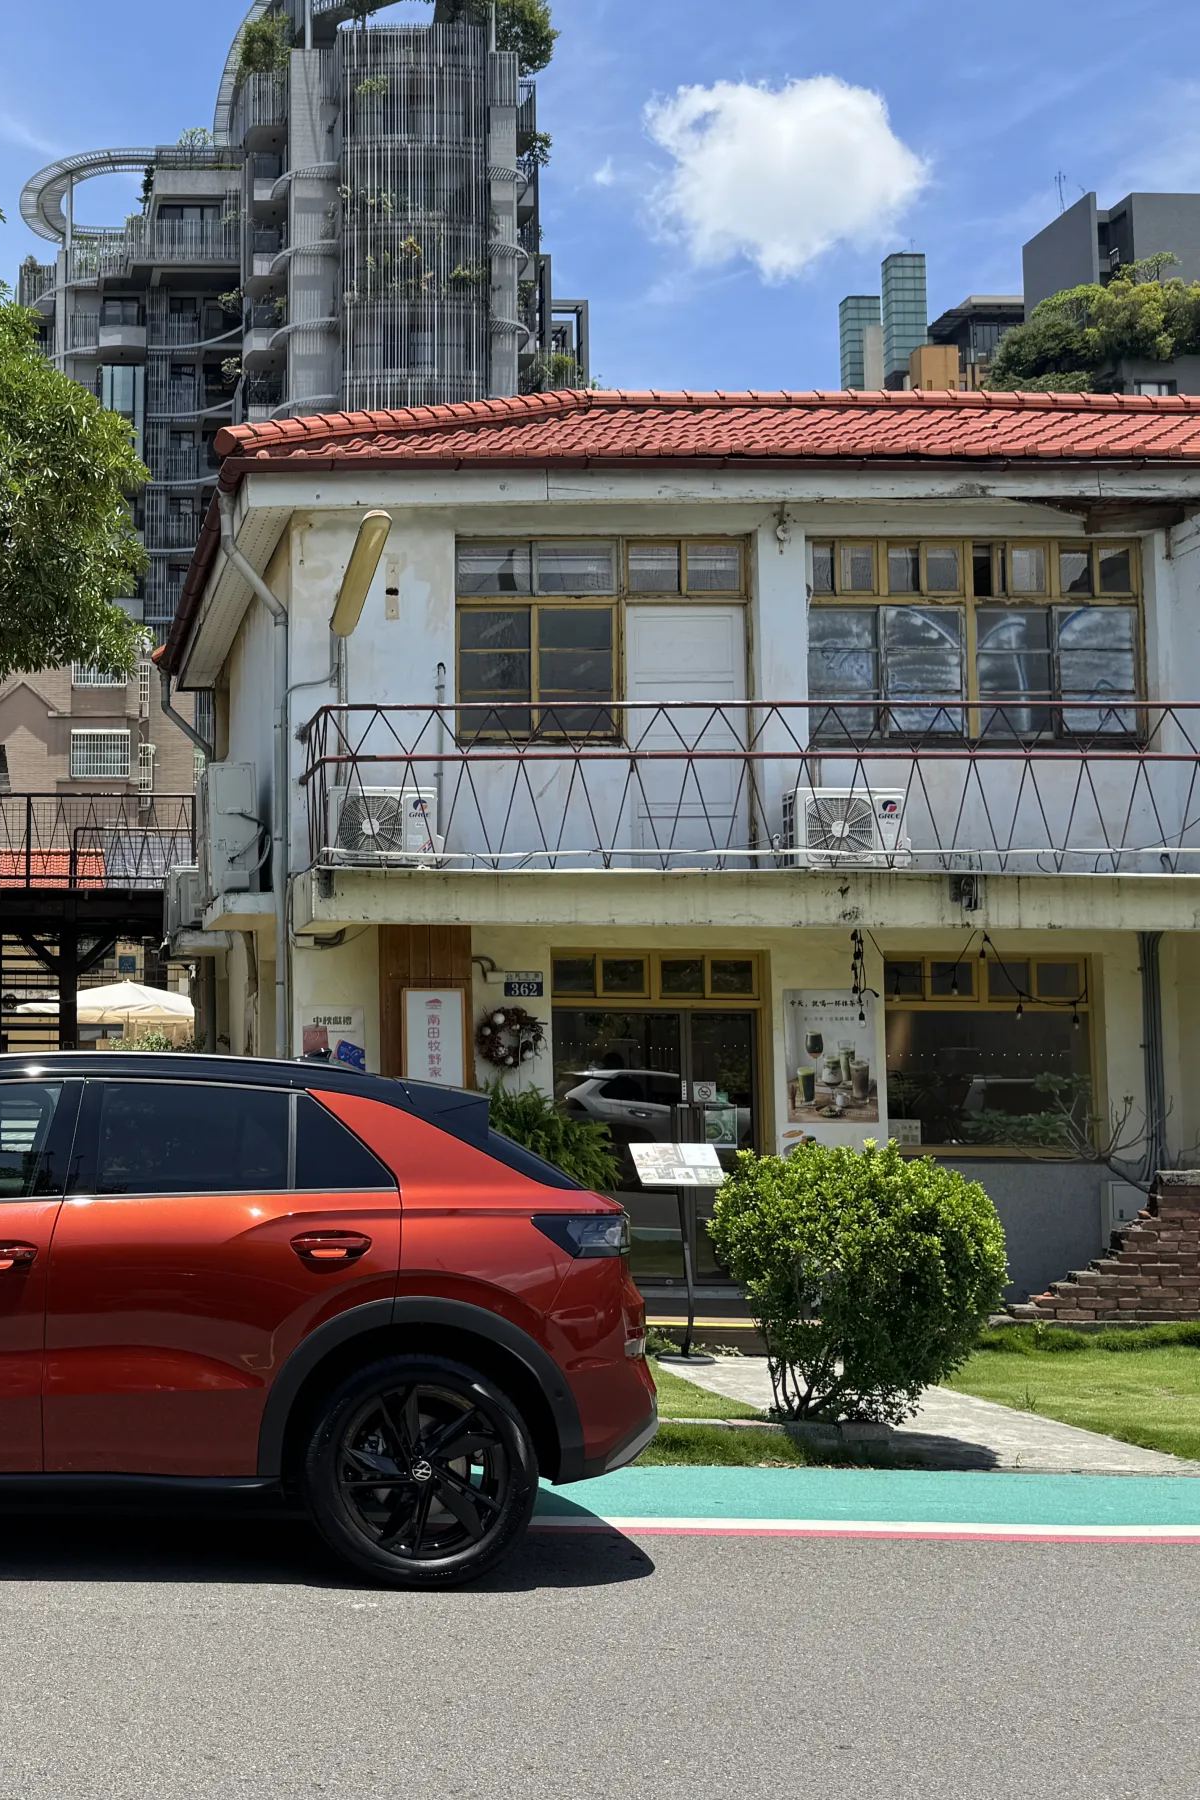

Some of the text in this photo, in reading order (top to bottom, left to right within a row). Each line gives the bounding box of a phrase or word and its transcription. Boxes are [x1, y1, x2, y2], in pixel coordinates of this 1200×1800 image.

[878, 812, 902, 820] GREE
[511, 983, 538, 996] 362
[427, 1014, 442, 1078] 南田牧野家
